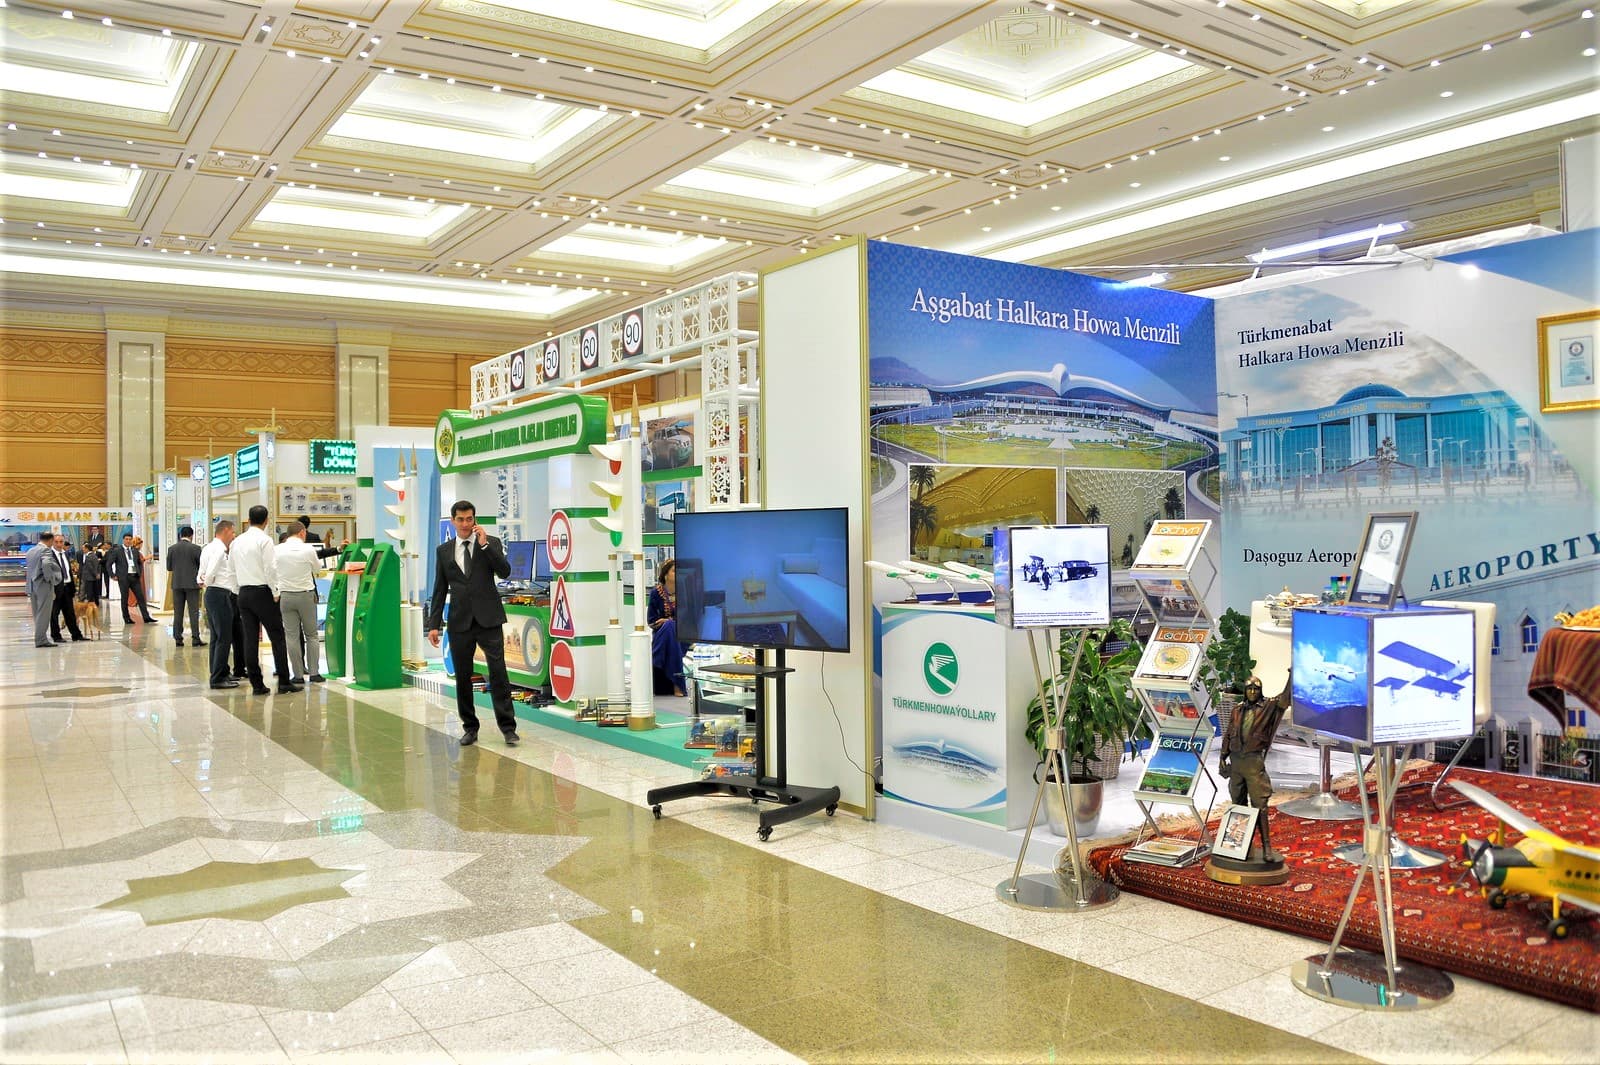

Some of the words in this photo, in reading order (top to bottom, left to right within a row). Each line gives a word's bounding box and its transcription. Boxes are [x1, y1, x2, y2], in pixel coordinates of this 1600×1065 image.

[911, 288, 992, 323] Aşgabat
[997, 298, 1069, 329] Halkara
[1073, 309, 1121, 337] Howa
[1124, 316, 1181, 345] Menzili
[625, 321, 640, 346] 90
[1238, 319, 1333, 345] Türkmenabat
[583, 336, 596, 359] 60
[1239, 350, 1294, 368] Halkara
[1298, 343, 1340, 360] Howa
[1345, 331, 1404, 354] Menzili
[512, 361, 523, 380] 40
[545, 350, 558, 371] 50
[37, 511, 92, 522] BALKAN
[1243, 548, 1303, 567] Daşoguz
[1430, 531, 1600, 592] AEROPORTY
[1158, 629, 1204, 642] Lachyn
[892, 696, 997, 723] TÜRKMENHOWAÝOLLARY
[1158, 736, 1203, 751] Lachyn
